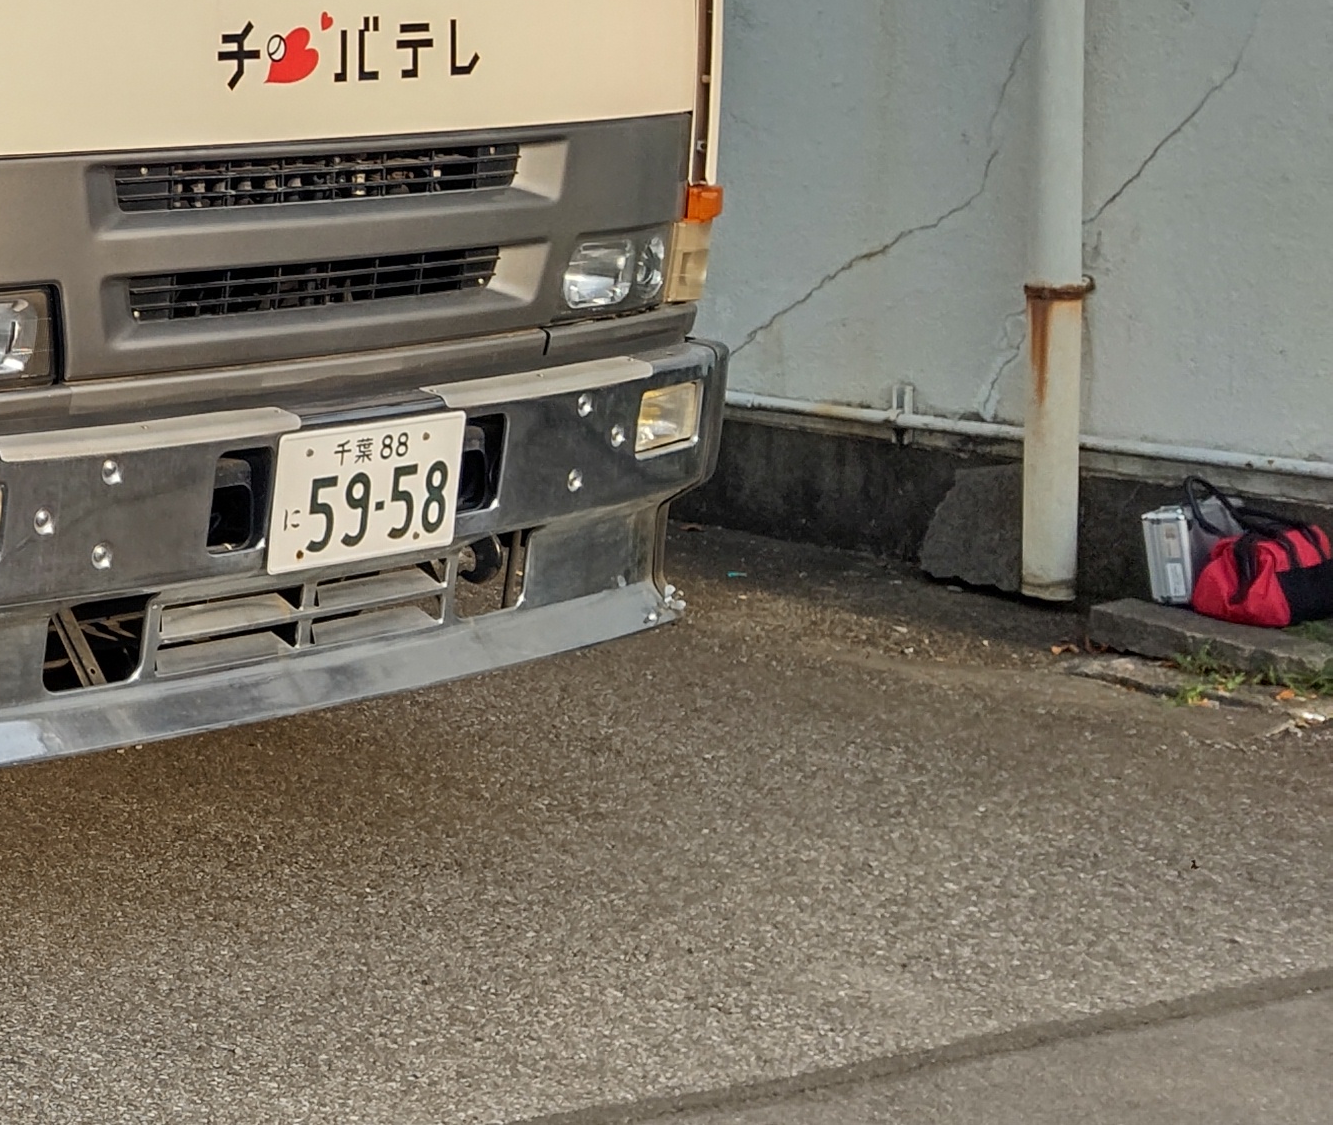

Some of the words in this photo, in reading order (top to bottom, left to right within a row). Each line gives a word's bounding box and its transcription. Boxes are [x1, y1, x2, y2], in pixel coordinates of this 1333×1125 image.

[217, 15, 480, 92] チバテレ
[334, 437, 374, 466] 千葉
[379, 431, 410, 460] 88
[283, 508, 301, 532] に
[305, 460, 449, 554] 59-58
